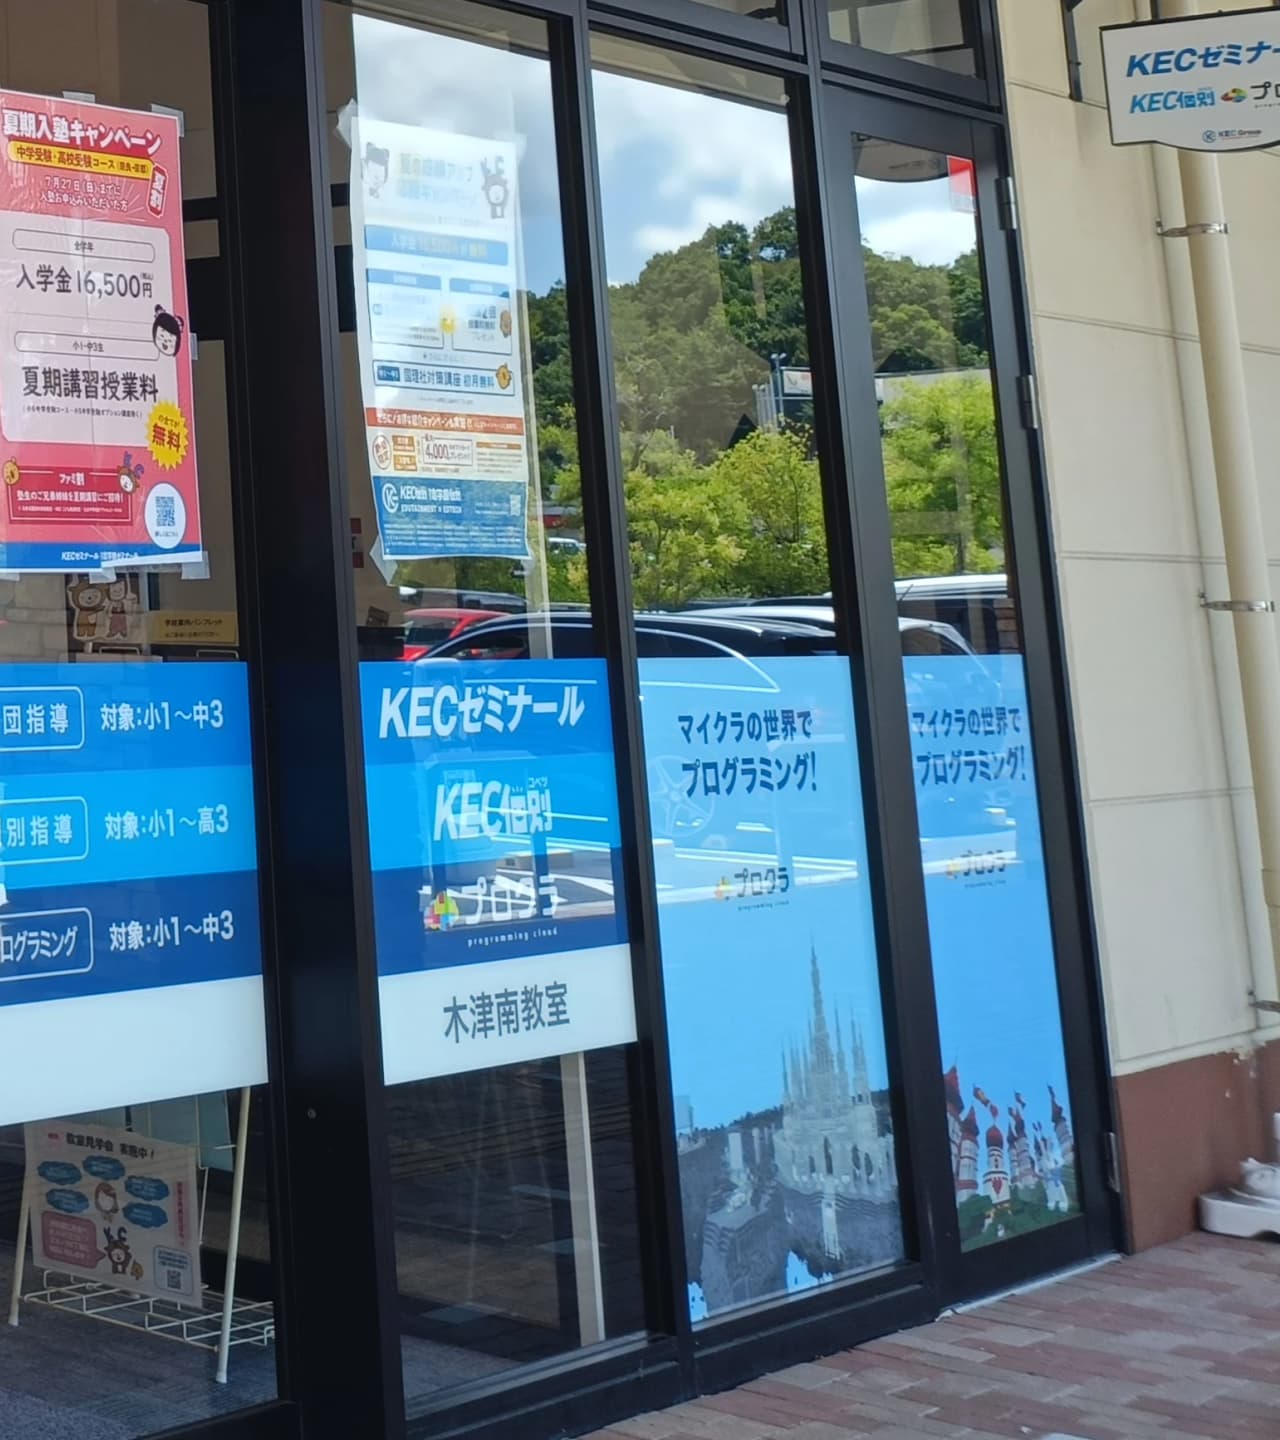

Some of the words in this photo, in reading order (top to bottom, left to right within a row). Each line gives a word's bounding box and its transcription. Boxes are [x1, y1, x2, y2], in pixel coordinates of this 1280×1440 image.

[22, 366, 159, 403] 夏期講習授業料
[152, 424, 181, 452] 無料
[379, 684, 585, 739] KECゼミナール
[678, 708, 813, 745] マイクラの世界で
[912, 706, 1021, 738] マイクラの世界で
[682, 751, 818, 798] プログラミング!
[443, 981, 570, 1044] 木津南教室
